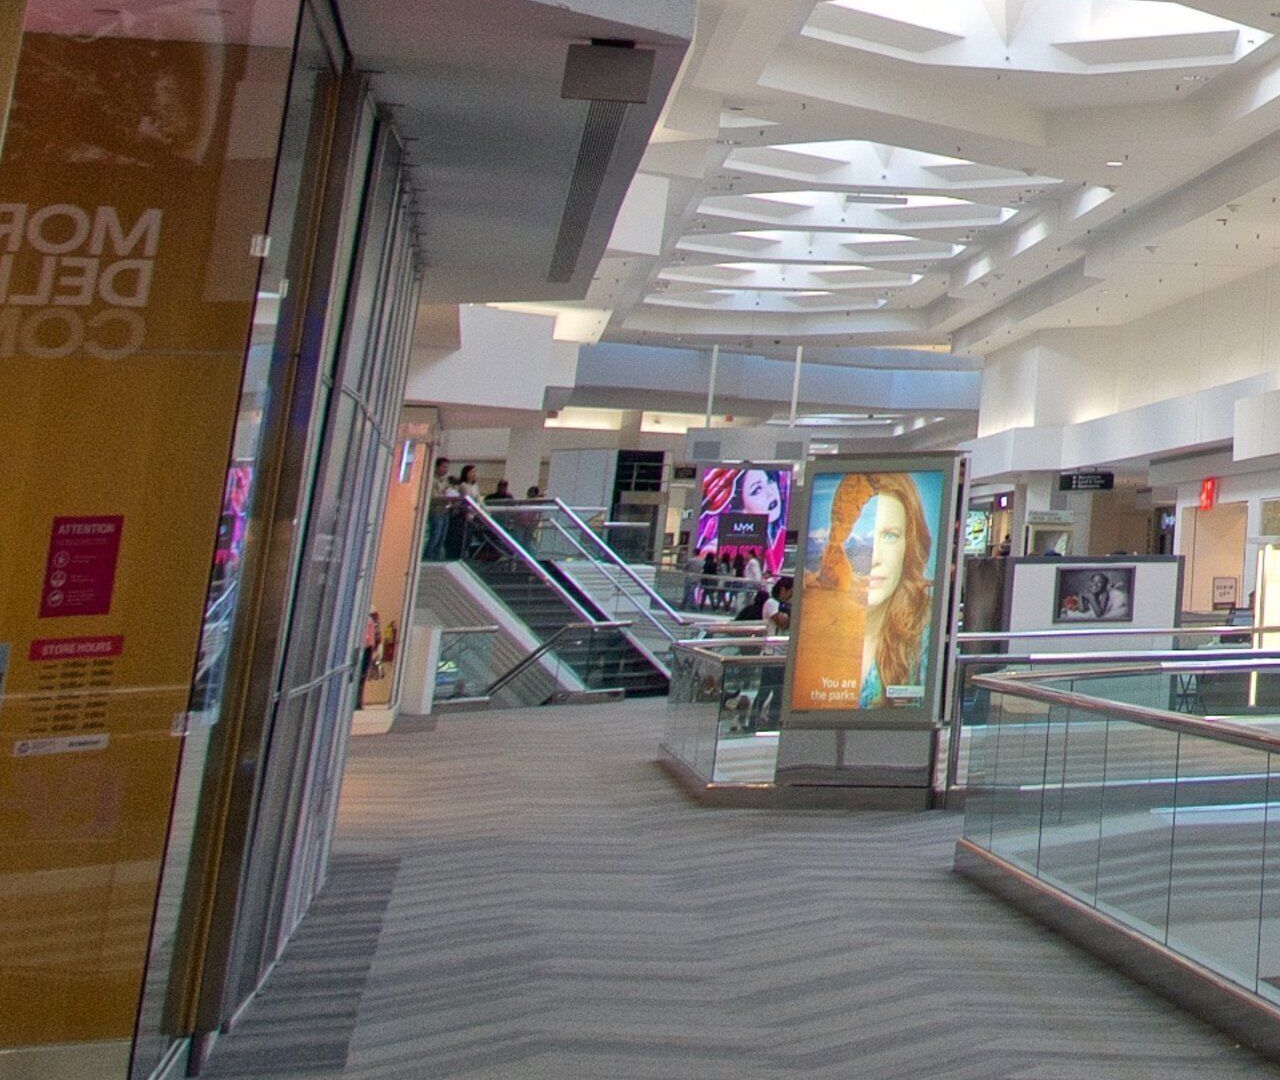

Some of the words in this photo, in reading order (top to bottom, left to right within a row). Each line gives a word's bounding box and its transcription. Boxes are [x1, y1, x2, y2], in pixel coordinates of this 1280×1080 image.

[822, 677, 839, 689] You
[841, 679, 857, 689] are
[811, 688, 827, 700] the
